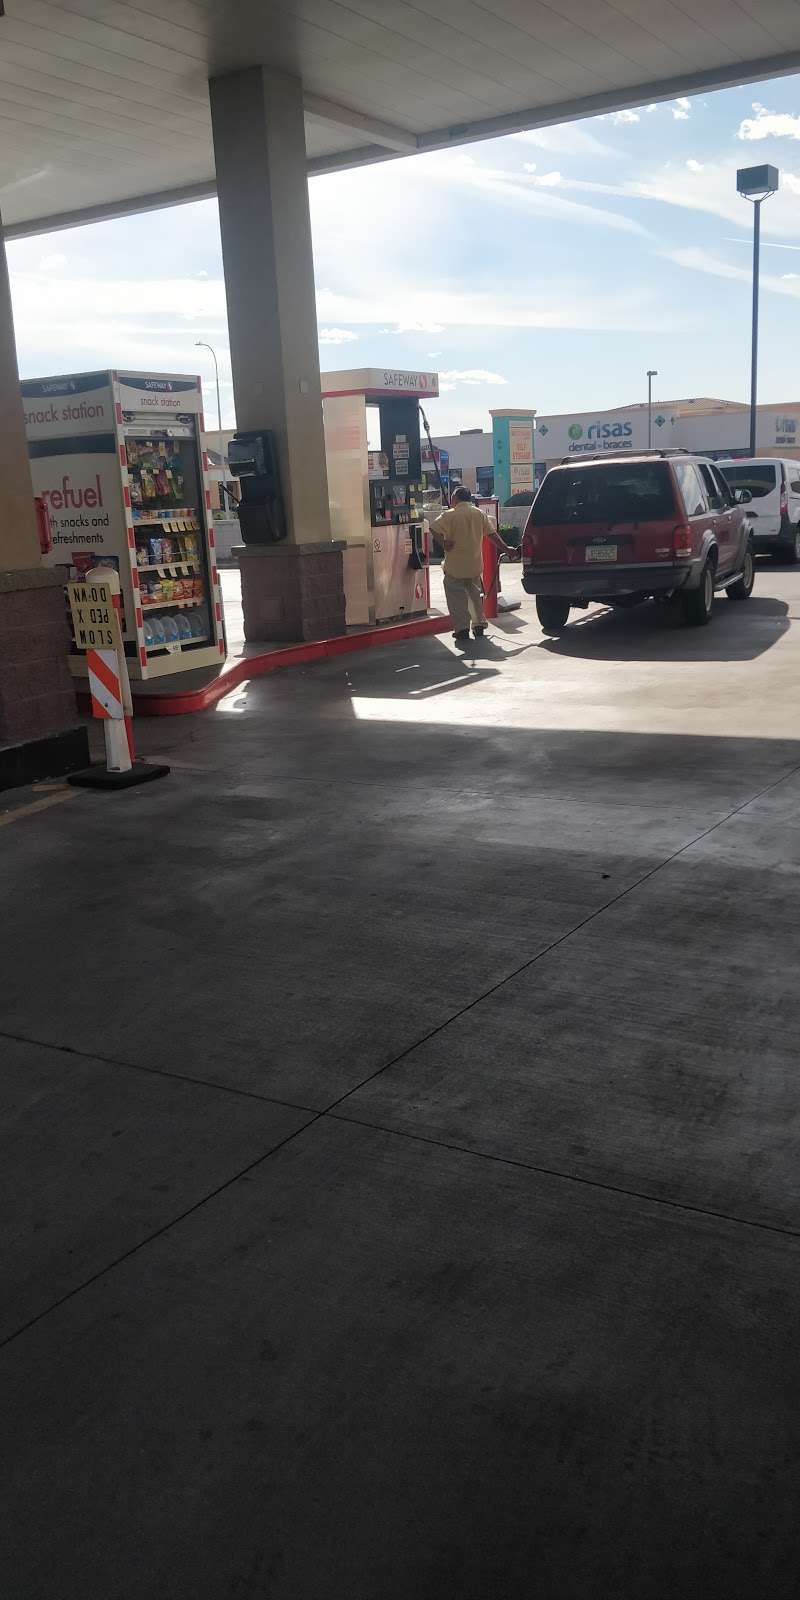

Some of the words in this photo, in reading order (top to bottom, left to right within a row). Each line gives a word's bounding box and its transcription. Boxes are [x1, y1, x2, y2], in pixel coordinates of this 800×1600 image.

[144, 381, 167, 390] SAFEWAY
[384, 372, 418, 387] SAFEWAY
[140, 396, 160, 406] snack
[160, 396, 181, 407] station
[23, 404, 58, 425] snack
[62, 401, 104, 422] station
[587, 420, 633, 440] risas
[568, 442, 597, 452] dental
[603, 440, 632, 450] braces
[41, 474, 104, 510] refuel
[60, 514, 90, 528] snacks
[91, 513, 110, 527] and
[52, 531, 104, 545] efreshments
[76, 609, 84, 624] X
[89, 608, 109, 624] PED
[79, 630, 113, 645] SLOW
